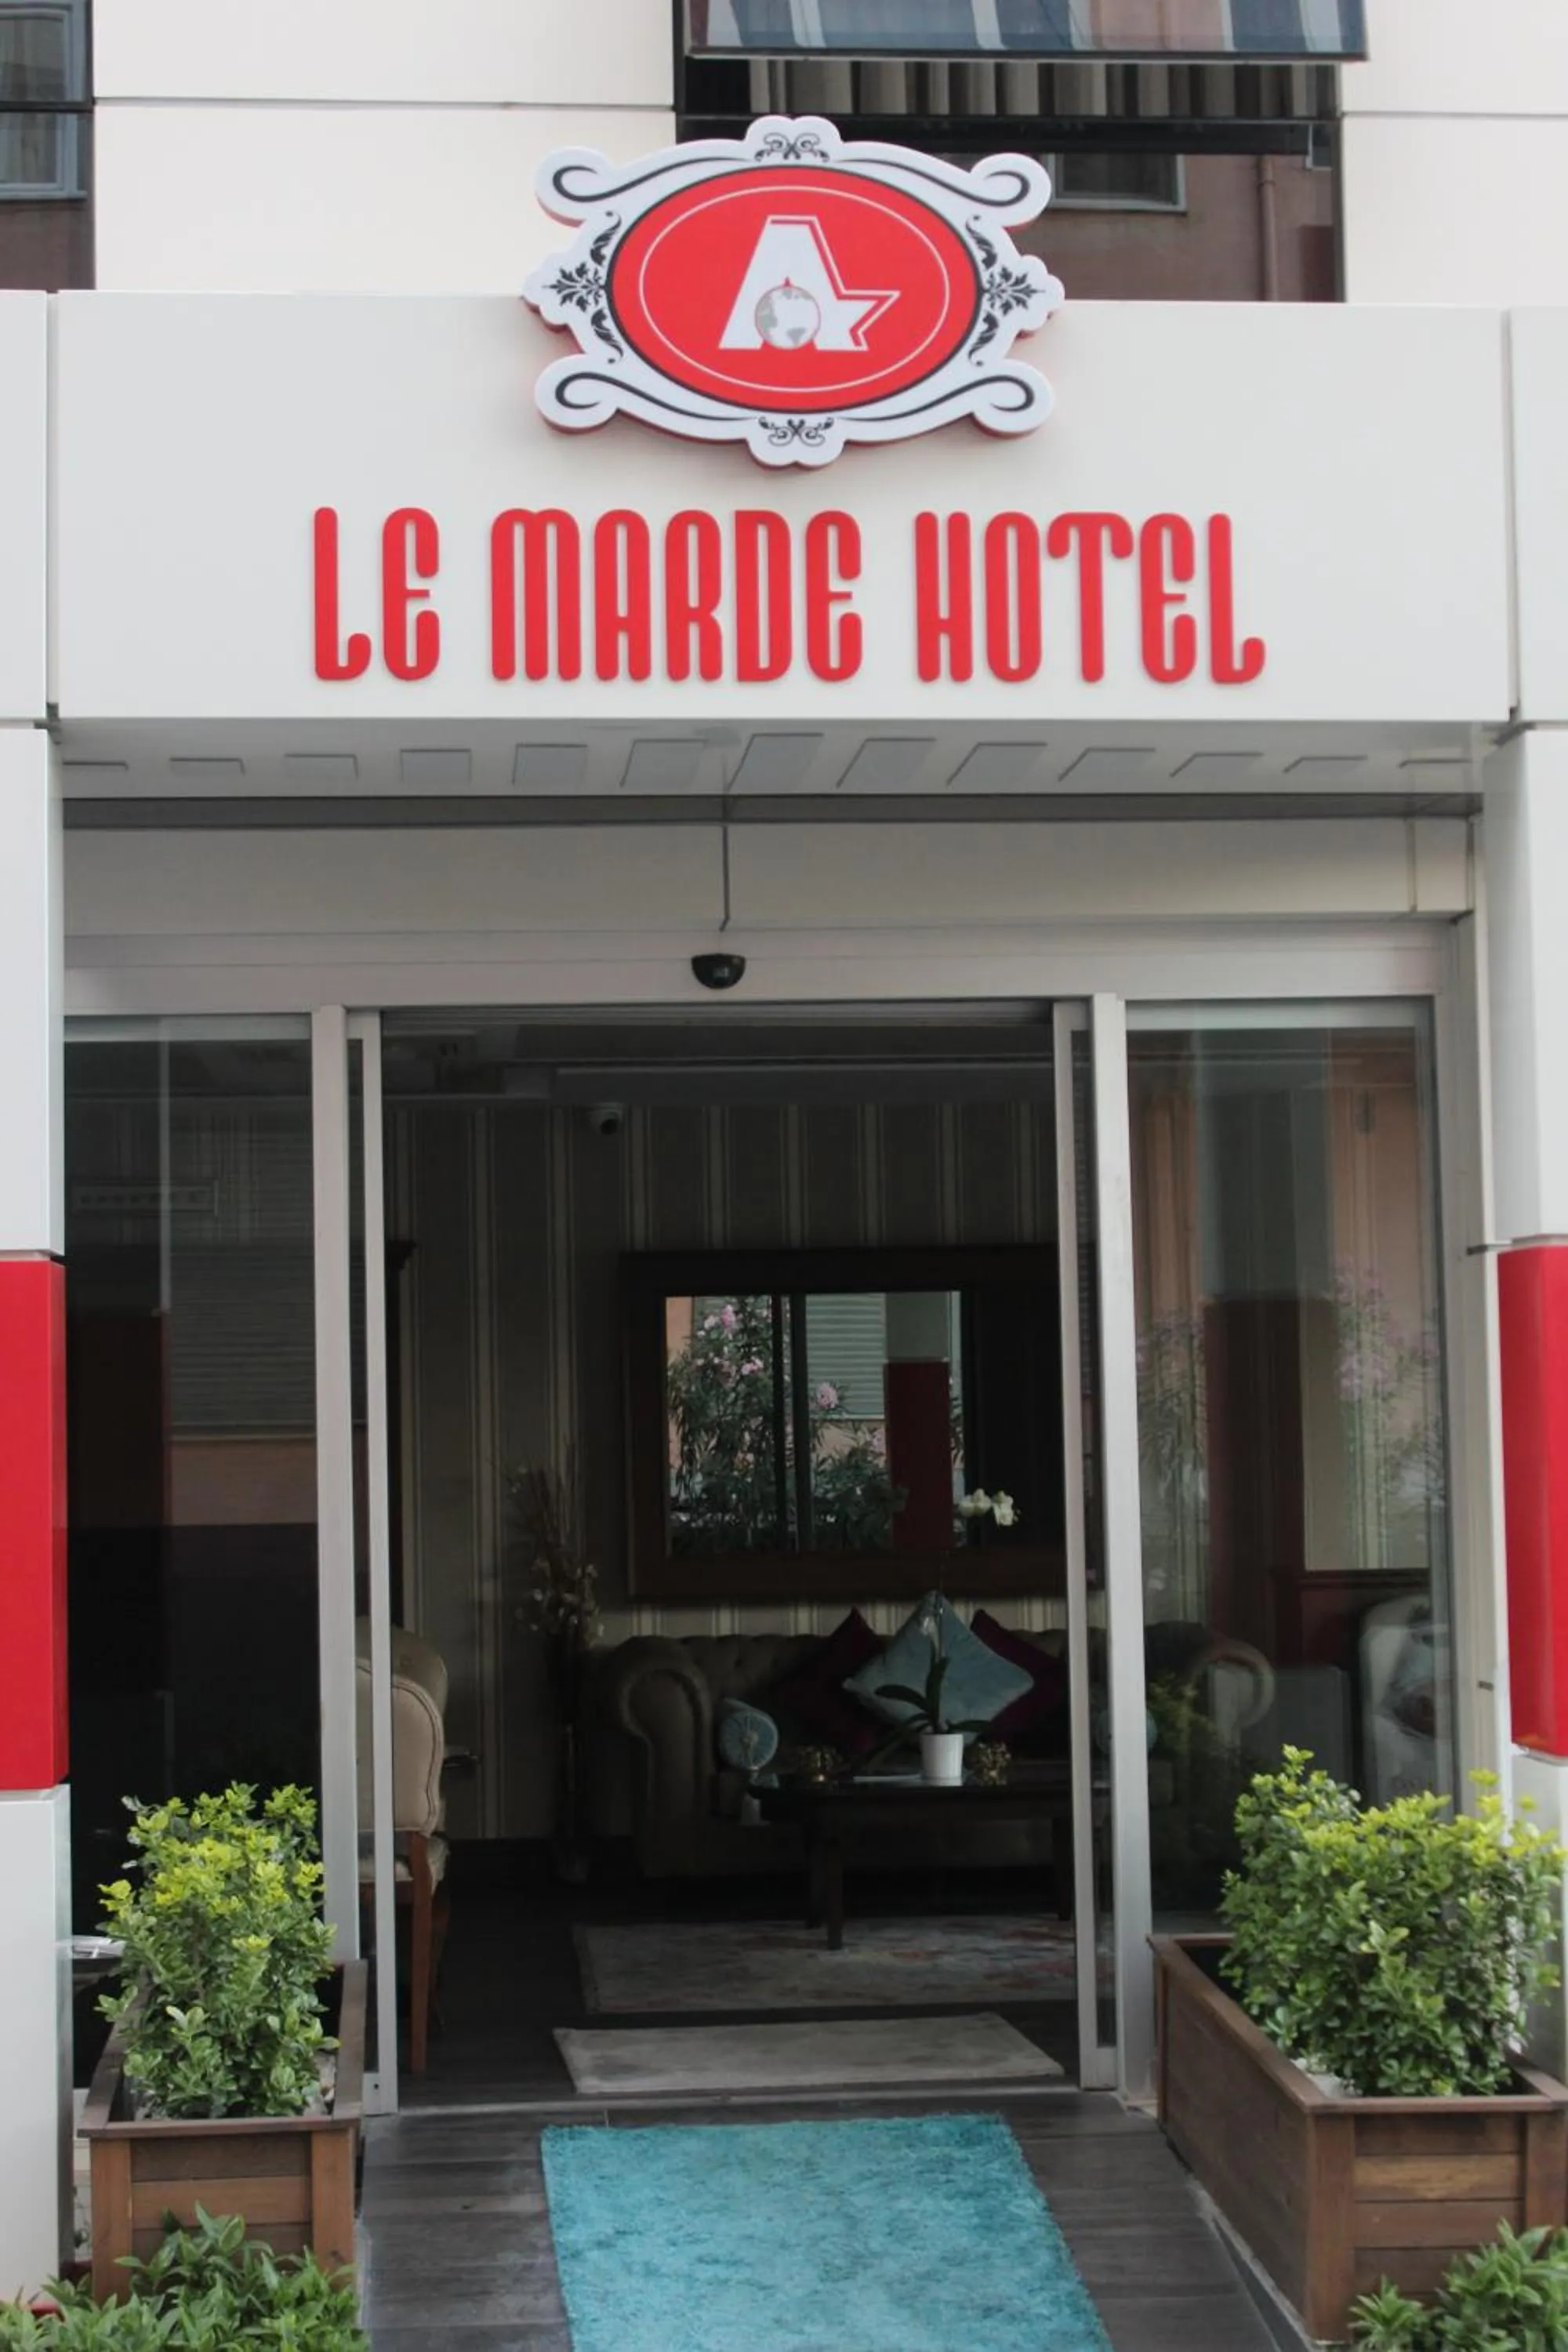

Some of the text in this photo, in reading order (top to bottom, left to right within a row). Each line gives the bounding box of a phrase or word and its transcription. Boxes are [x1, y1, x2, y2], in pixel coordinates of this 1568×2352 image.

[314, 507, 1265, 684] LE MARDE HOTEL
